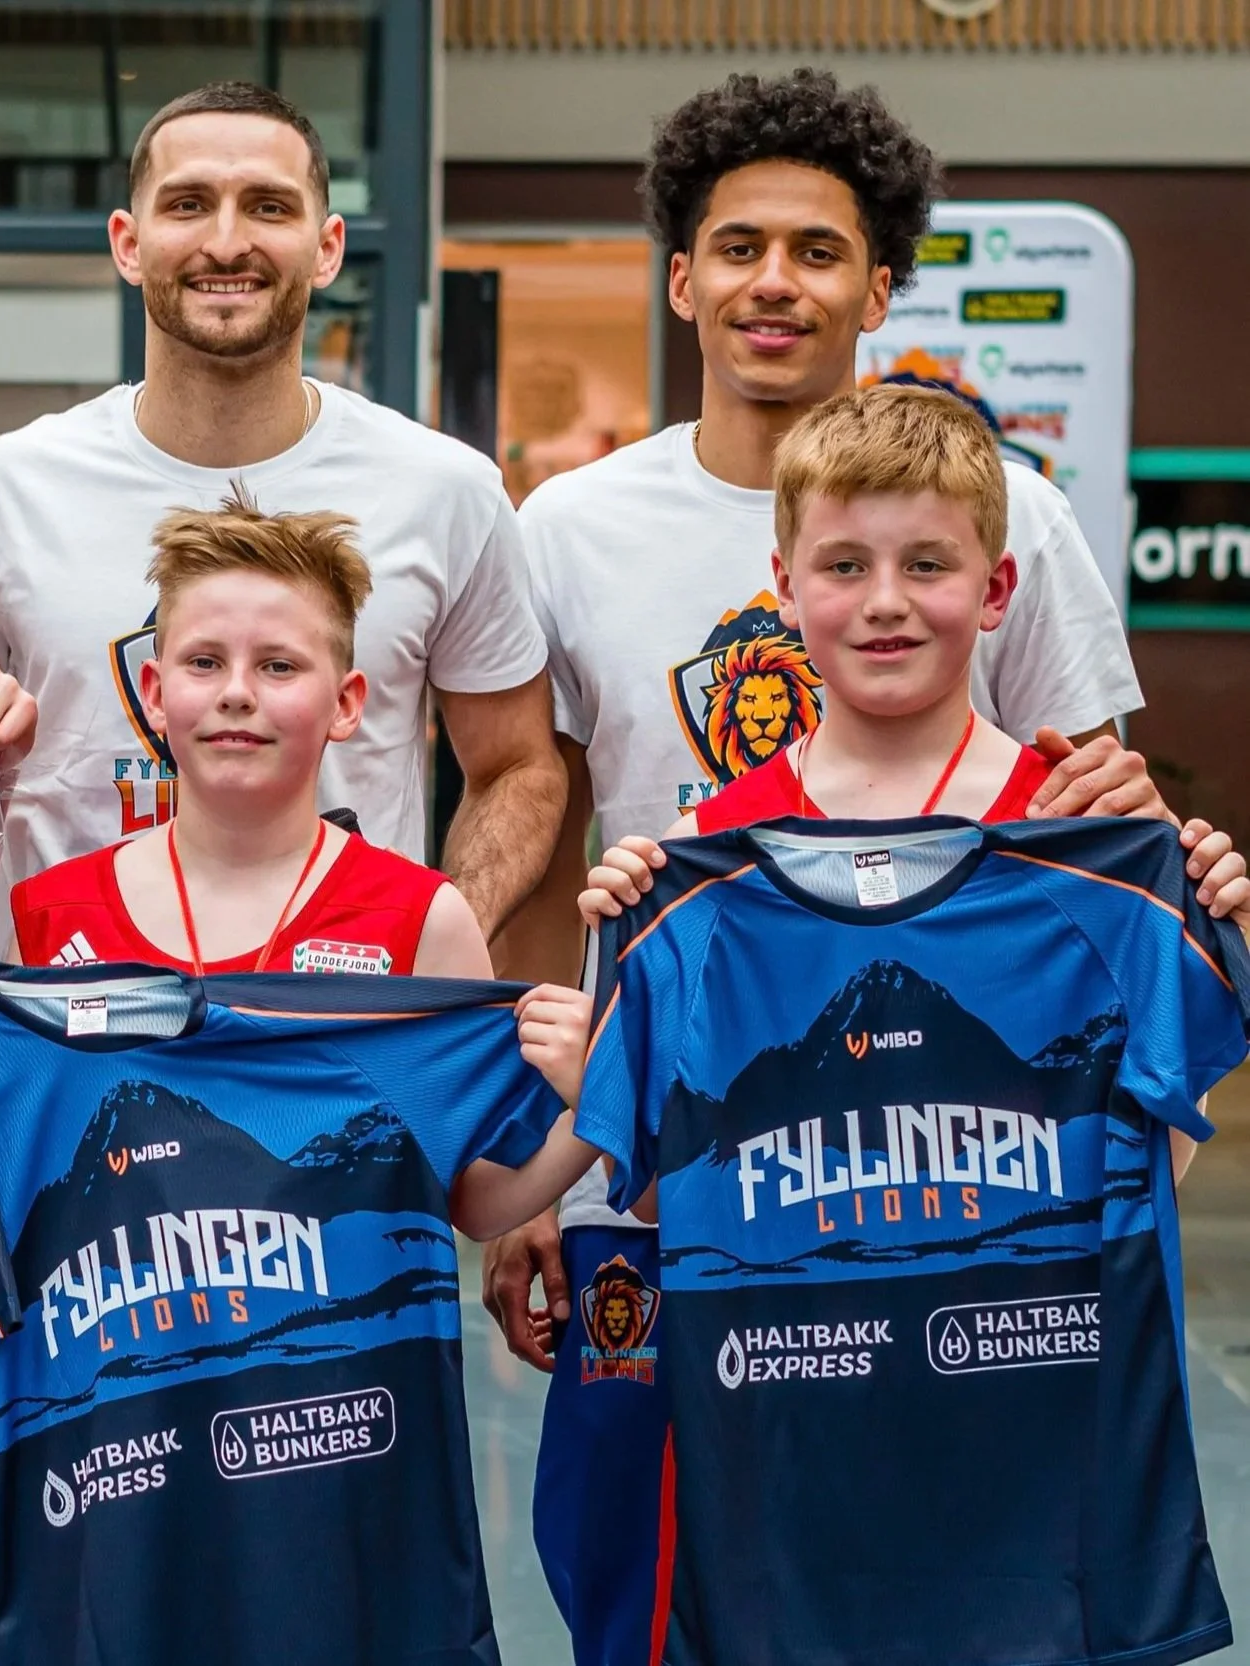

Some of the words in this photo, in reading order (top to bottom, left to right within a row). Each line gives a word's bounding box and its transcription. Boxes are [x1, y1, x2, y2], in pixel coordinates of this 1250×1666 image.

[308, 954, 376, 972] LODDEFJORD
[872, 1030, 923, 1050] WIBO
[131, 1141, 181, 1163] WIBO
[817, 1186, 981, 1233] LIONS
[100, 1289, 249, 1352] LIONS
[975, 1302, 1101, 1335] HALTBAK
[745, 1319, 894, 1352] HALTBAKK
[977, 1330, 1101, 1361] BUNKERS
[748, 1351, 872, 1382] EXPRESS
[250, 1396, 385, 1439] HALTBAKK
[254, 1425, 372, 1466] BUNKERS
